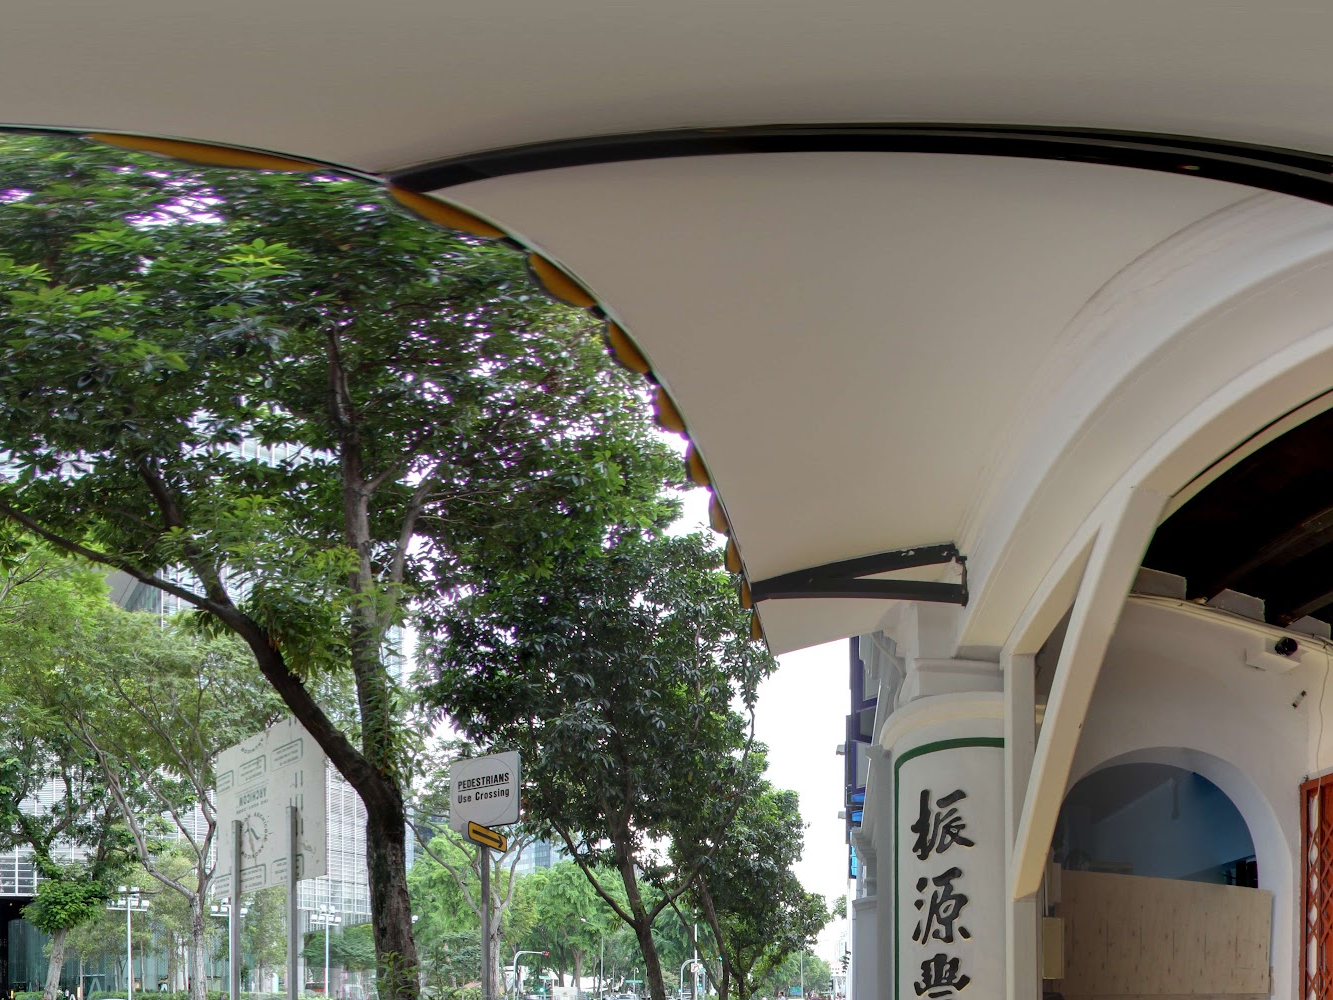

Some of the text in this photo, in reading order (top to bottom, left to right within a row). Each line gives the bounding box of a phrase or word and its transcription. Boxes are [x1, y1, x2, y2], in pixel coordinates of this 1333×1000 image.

[458, 772, 510, 790] PEDESTRIANS
[458, 788, 510, 804] Use Crossing
